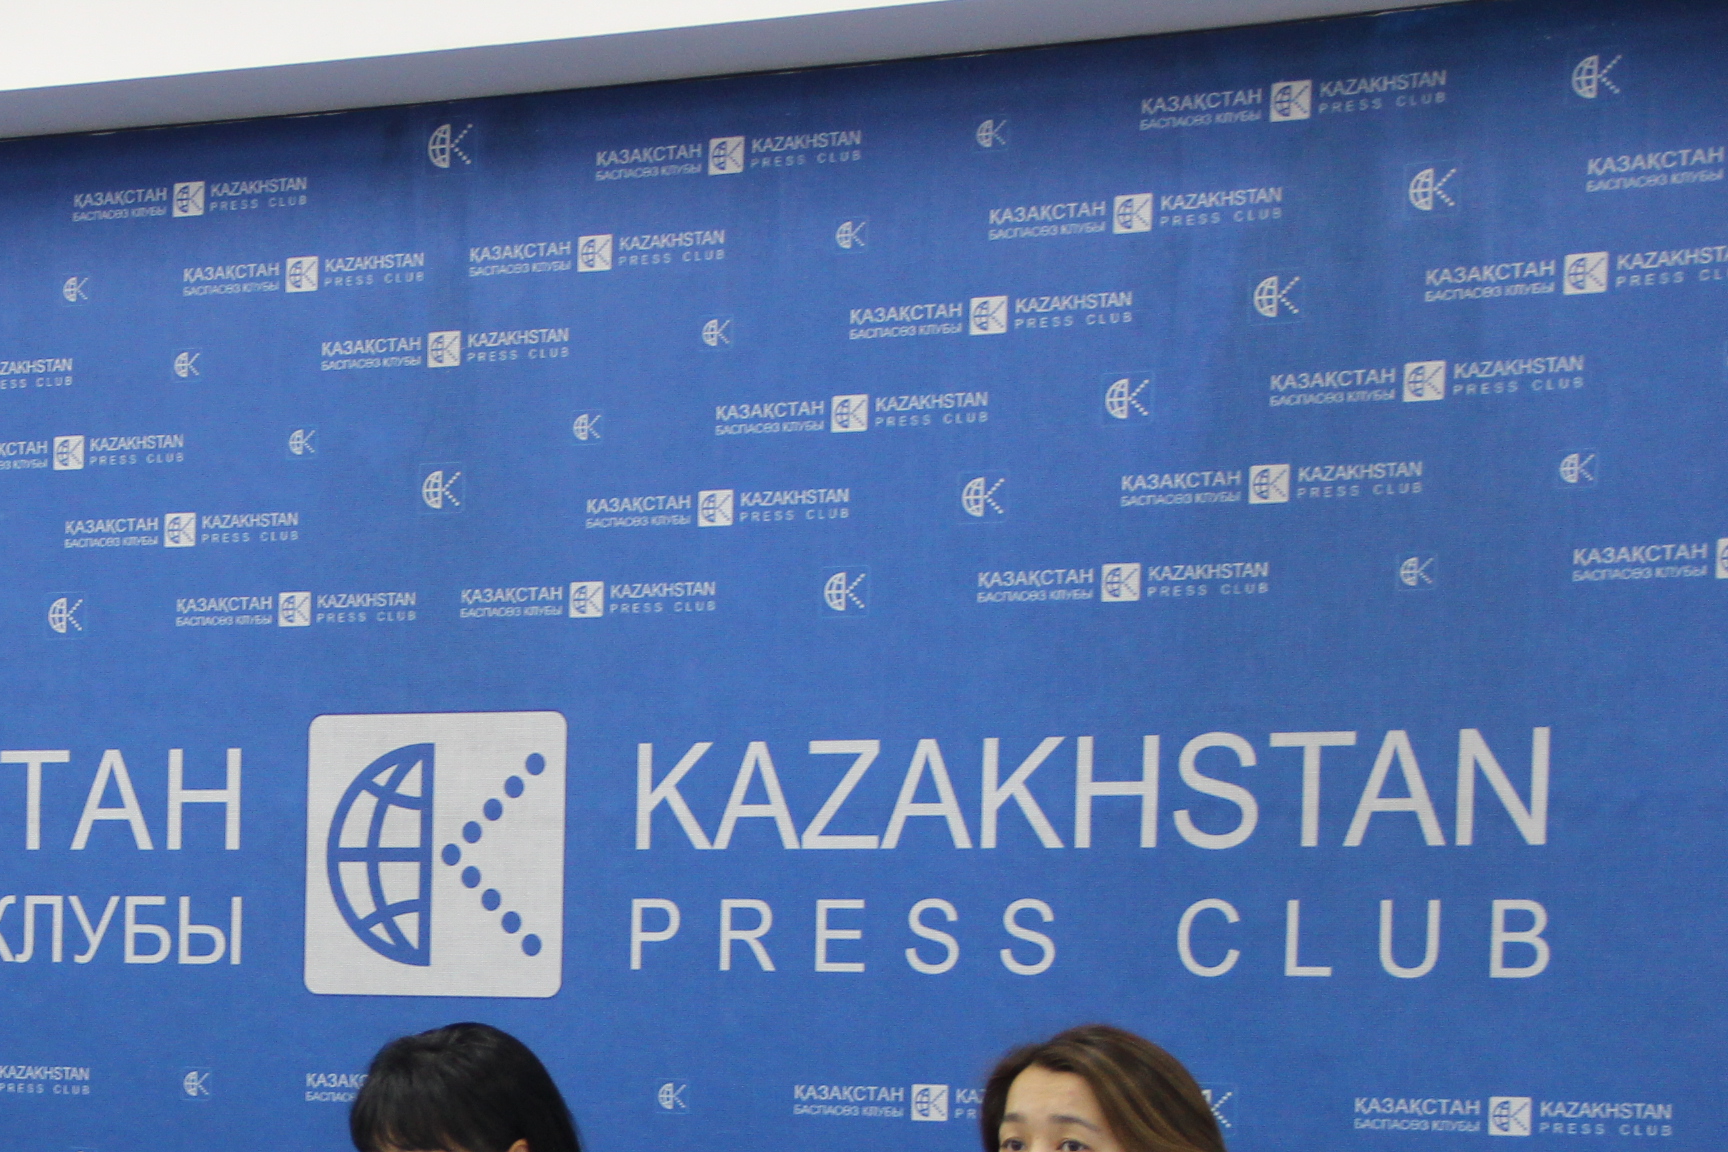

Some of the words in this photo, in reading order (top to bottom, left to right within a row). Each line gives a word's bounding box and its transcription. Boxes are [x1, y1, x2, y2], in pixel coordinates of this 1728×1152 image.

[1320, 70, 1448, 97] KAZAKHSTAN
[1318, 97, 1383, 114] PRESS
[1395, 91, 1446, 106] CLUB
[751, 130, 862, 153] KAZAKHSTAN
[750, 154, 807, 168] PRESS
[816, 150, 862, 163] CLUB
[210, 176, 308, 196] KAZAKHSTAN
[1160, 185, 1283, 212] KAZAKHSTAN
[1159, 212, 1221, 228] PRESS
[1232, 208, 1282, 222] CLUB
[619, 229, 726, 250] KAZAKHSTAN
[324, 252, 425, 272] KAZAKHSTAN
[618, 253, 672, 266] PRESS
[681, 249, 725, 261] CLUB
[1015, 291, 1133, 313] KAZAKHSTAN
[1014, 315, 1075, 329] PRESS
[1085, 312, 1133, 325] CLUB
[467, 327, 570, 348] KAZAKHSTAN
[1453, 355, 1585, 379] KAZAKHSTAN
[1452, 380, 1520, 396] PRESS
[1531, 376, 1584, 391] CLUB
[875, 391, 989, 412] KAZAKHSTAN
[874, 414, 932, 427] PRESS
[942, 411, 989, 423] CLUB
[89, 433, 184, 451] KAZAKHSTAN
[1297, 461, 1423, 482] KAZAKHSTAN
[740, 488, 850, 507] KAZAKHSTAN
[1297, 485, 1361, 499] PRESS
[1371, 482, 1423, 495] CLUB
[201, 511, 299, 529] KAZAKHSTAN
[739, 510, 796, 522] PRESS
[805, 508, 850, 519] CLUB
[1148, 562, 1269, 581] KAZAKHSTAN
[610, 581, 716, 598] KAZAKHSTAN
[1146, 584, 1208, 597] PRESS
[1220, 582, 1269, 594] CLUB
[317, 592, 417, 608] KAZAKHSTAN
[609, 602, 664, 613] PRESS
[673, 601, 716, 611] CLUB
[635, 726, 1551, 850] KAZAKHSTAN
[630, 898, 1056, 976] PRESS
[1177, 898, 1551, 979] CLUB
[1540, 1101, 1673, 1119] KAZAKHSTAN
[1539, 1123, 1607, 1135] PRESS
[1618, 1125, 1673, 1136] CLUB
